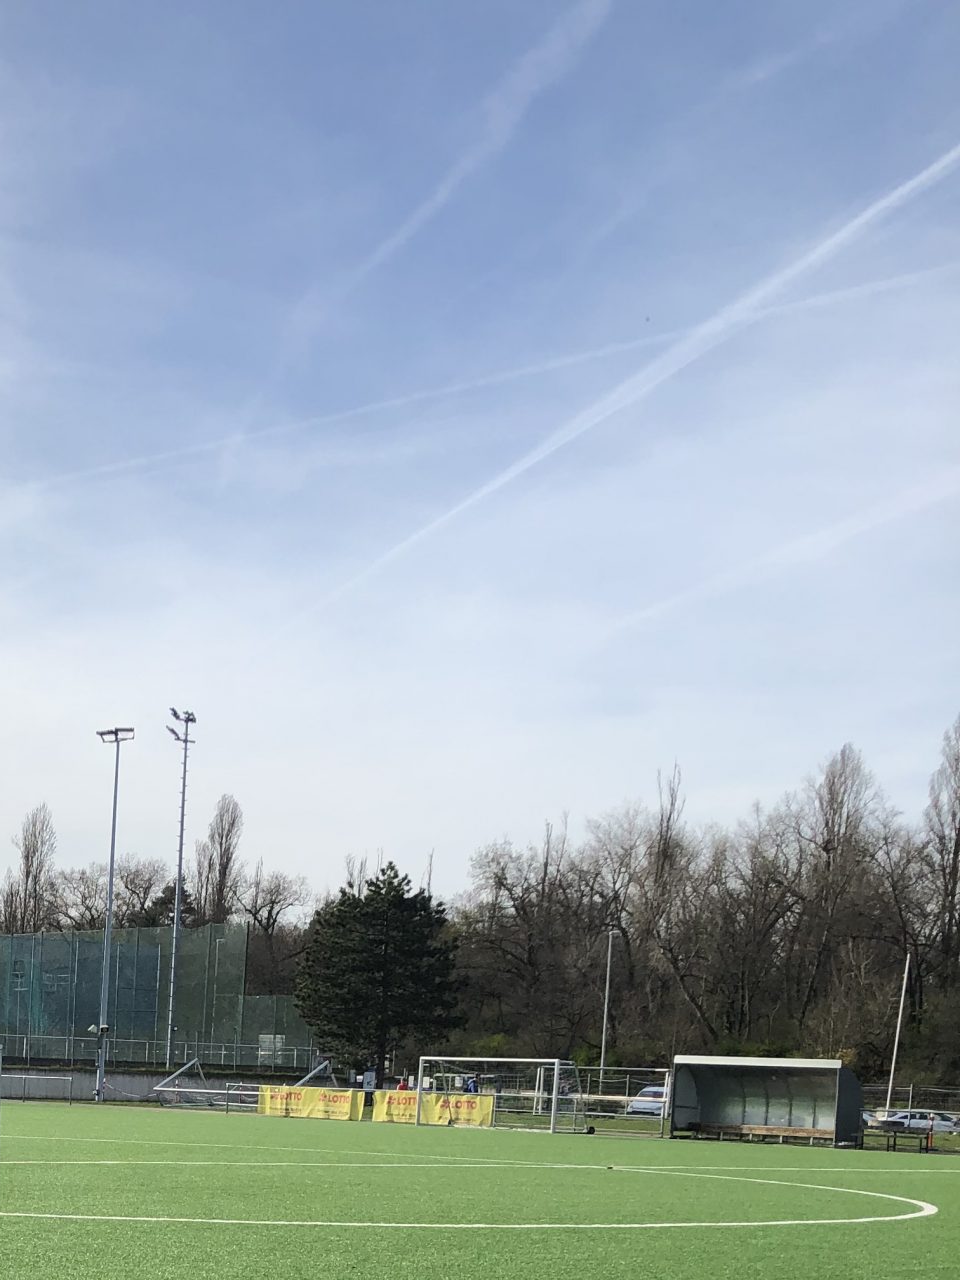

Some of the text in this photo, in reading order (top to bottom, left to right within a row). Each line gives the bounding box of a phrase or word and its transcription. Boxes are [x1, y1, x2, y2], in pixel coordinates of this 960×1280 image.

[327, 1094, 351, 1104] LOTTO
[397, 1096, 417, 1106] LOTT
[450, 1100, 477, 1110] LOTTO
